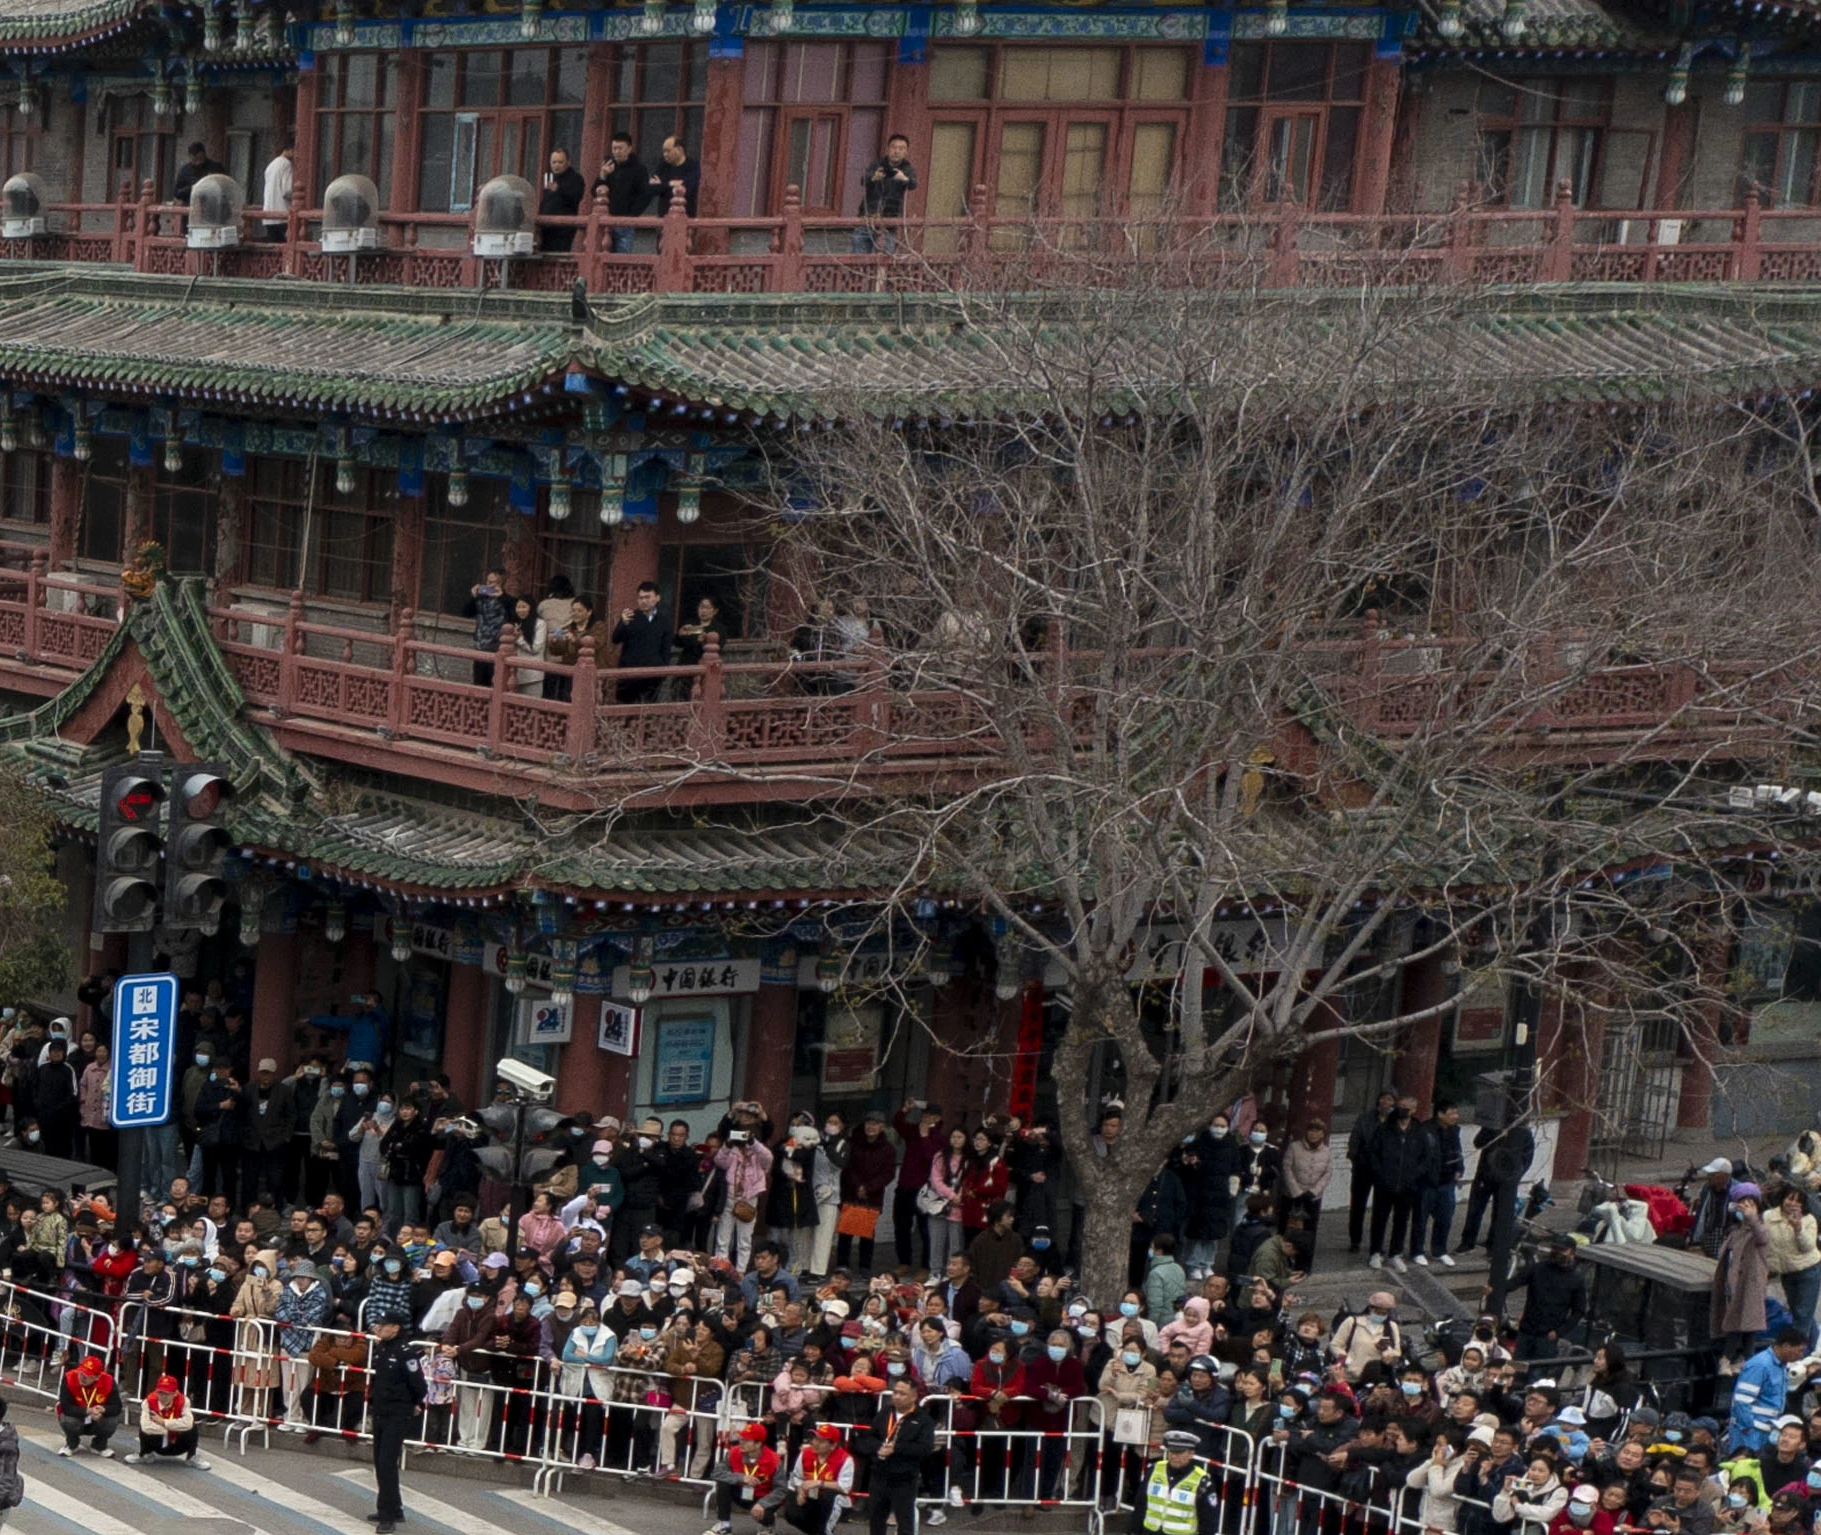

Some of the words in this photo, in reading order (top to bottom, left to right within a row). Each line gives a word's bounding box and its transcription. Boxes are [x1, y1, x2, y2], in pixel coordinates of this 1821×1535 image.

[413, 925, 450, 956] 国银行
[662, 965, 739, 992] 中国银行
[138, 988, 153, 1004] 北
[125, 1016, 160, 1115] 宋都御街
